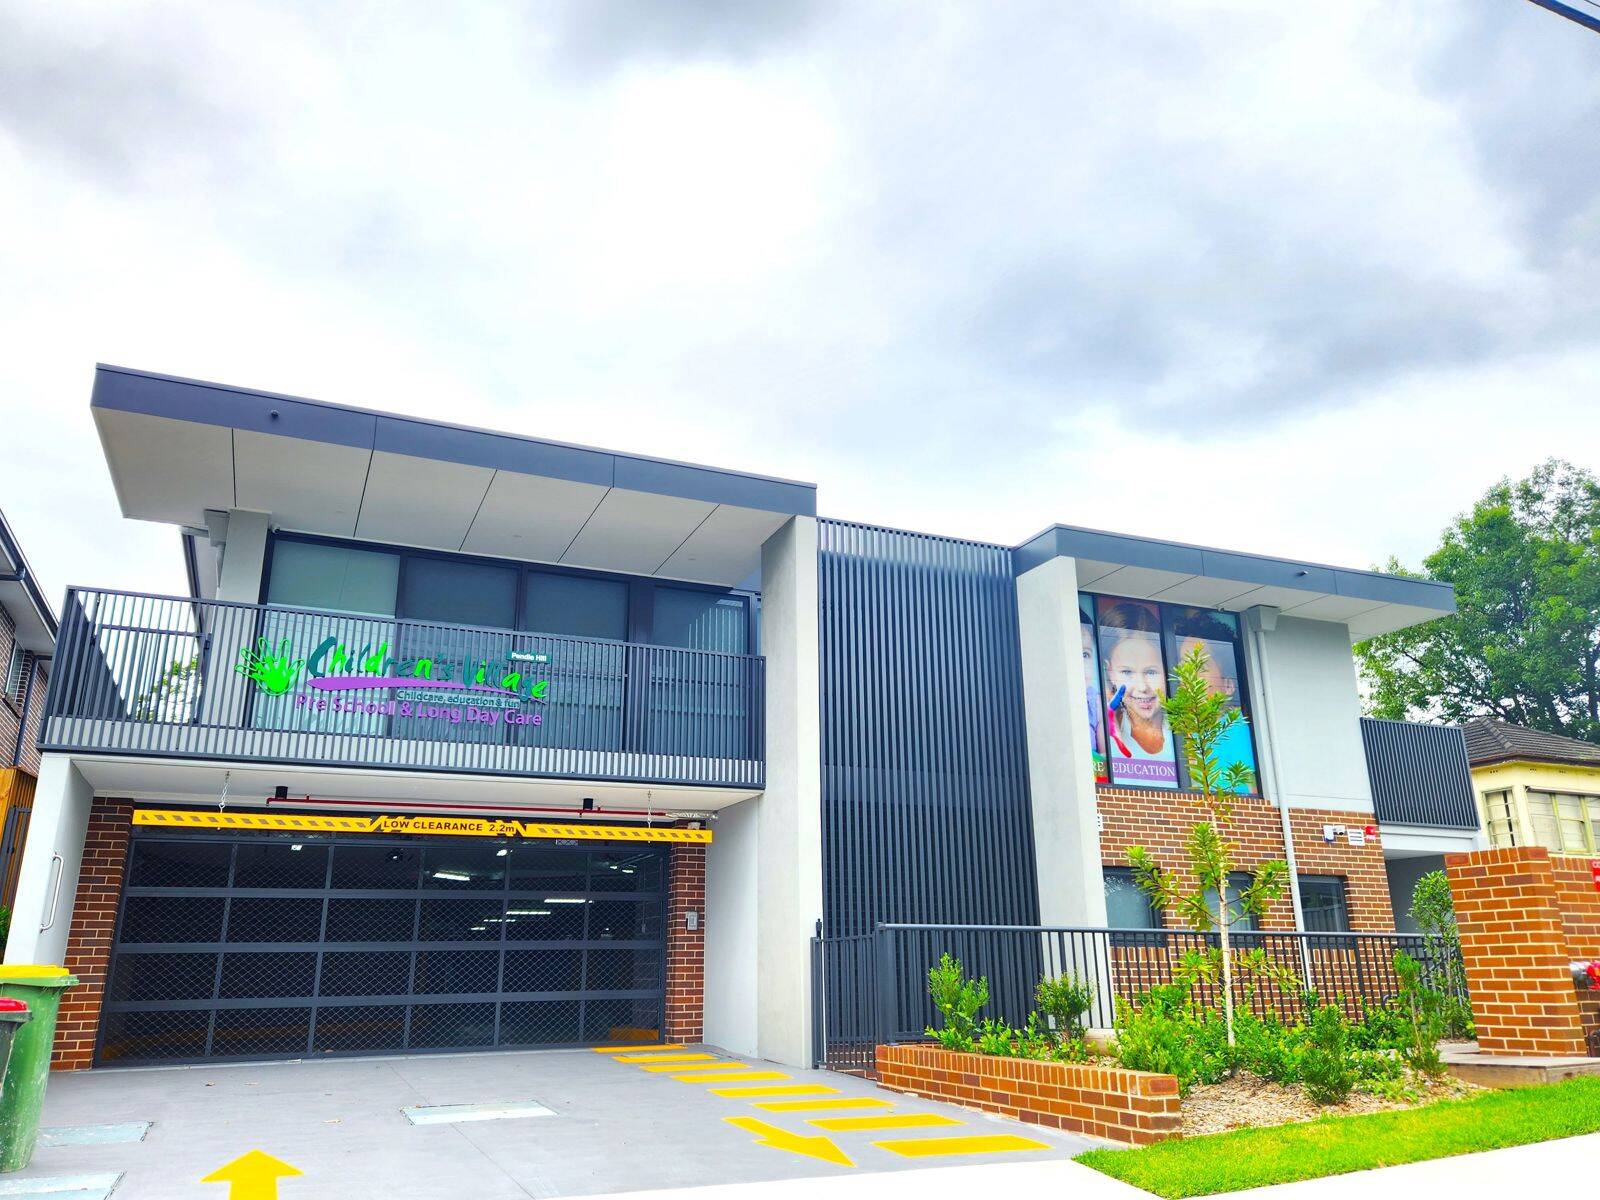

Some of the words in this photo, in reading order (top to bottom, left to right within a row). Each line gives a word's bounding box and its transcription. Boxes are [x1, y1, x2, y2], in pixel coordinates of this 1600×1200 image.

[511, 652, 535, 661] Pendle
[308, 636, 455, 681] Children's
[463, 651, 549, 702] Village
[448, 693, 495, 706] education
[504, 698, 520, 709] fun
[296, 693, 327, 711] Pre
[333, 696, 396, 715] School
[400, 701, 414, 718] &
[417, 703, 462, 724] Long
[466, 706, 500, 726] Day
[504, 709, 542, 727] Care
[1112, 762, 1175, 777] EDUCATION
[383, 820, 410, 829] LOW
[413, 821, 483, 832] CLEARANCE
[488, 824, 515, 833] 2.2m
